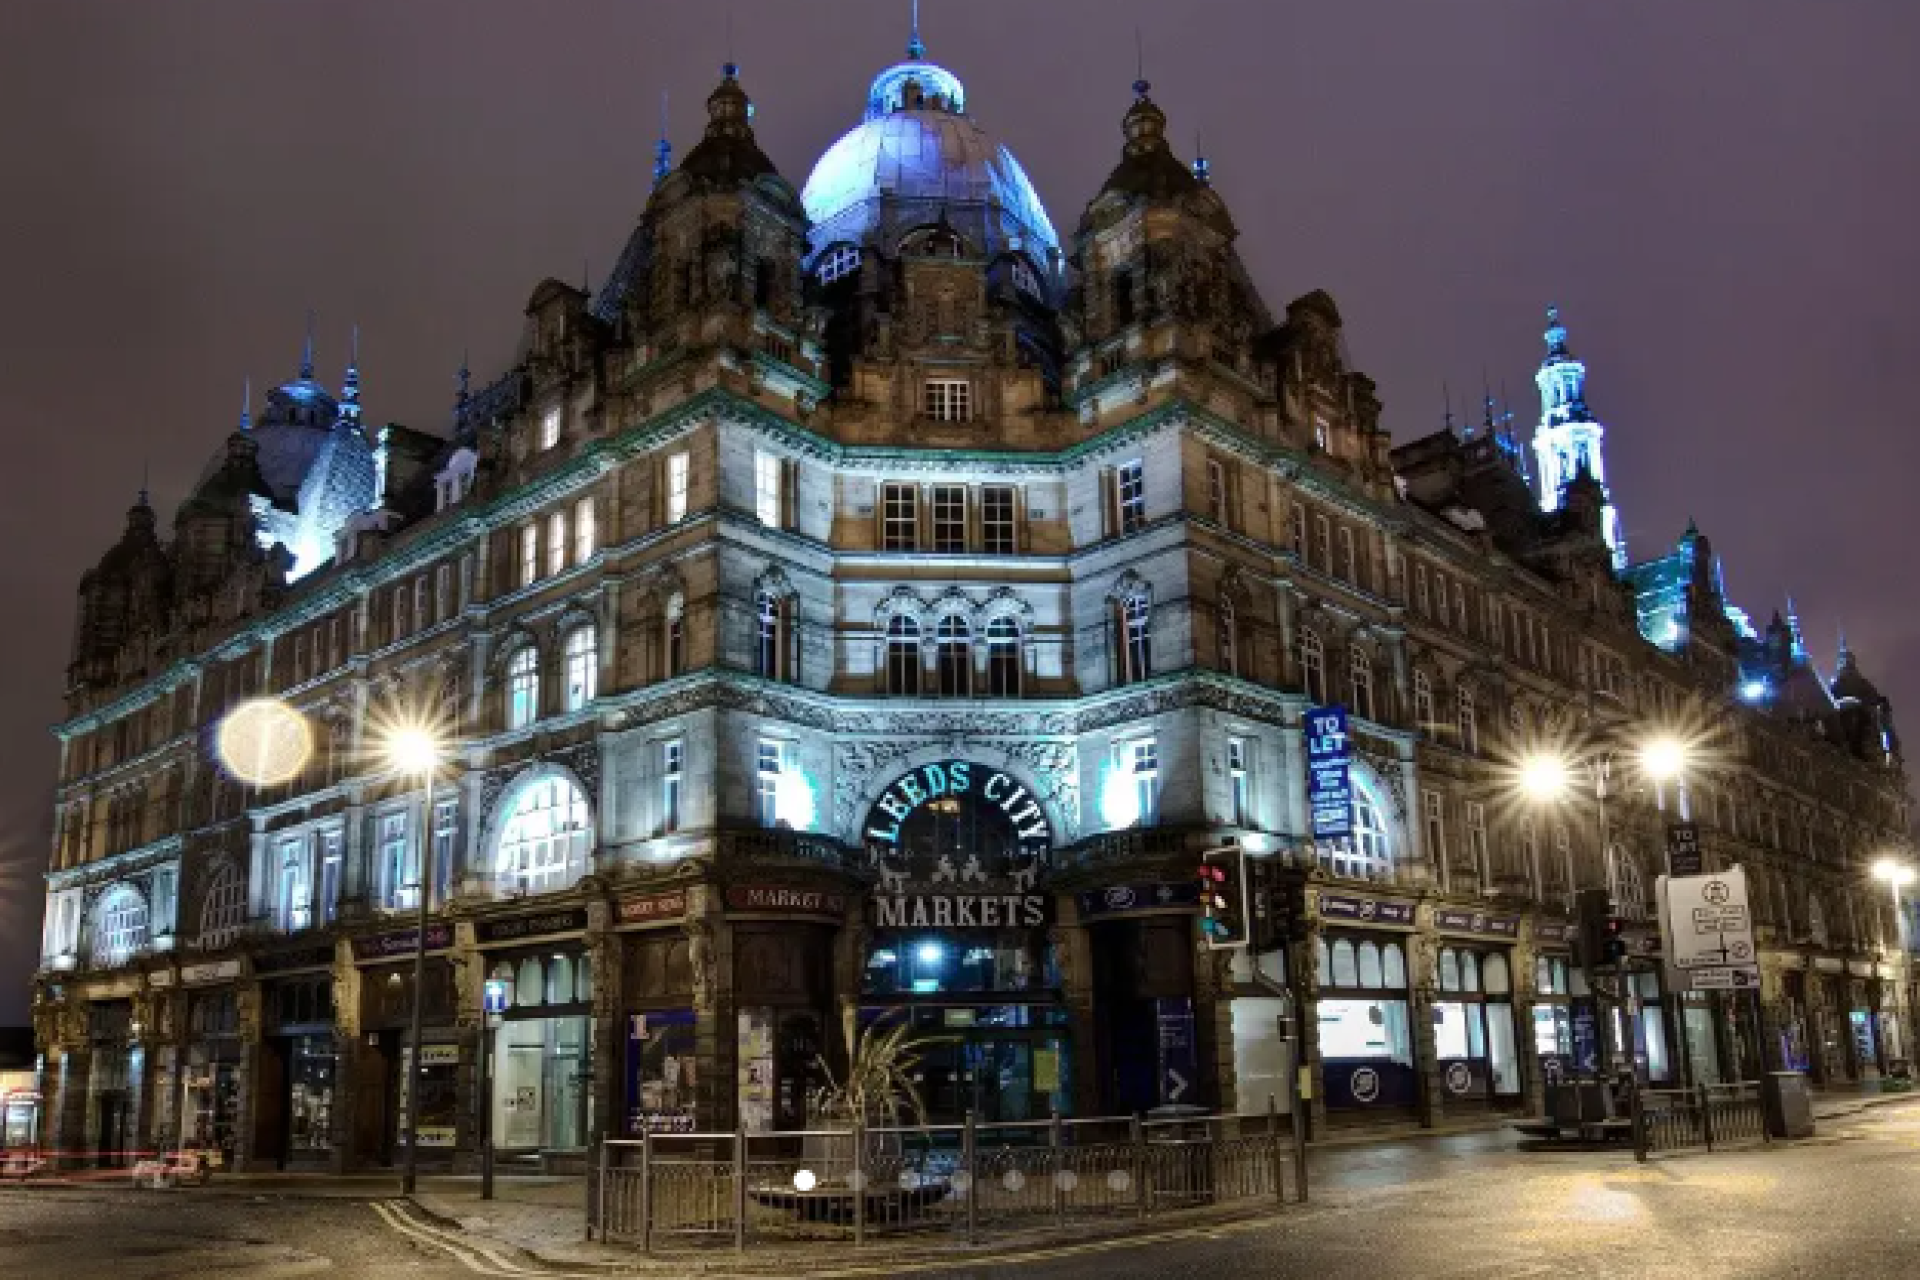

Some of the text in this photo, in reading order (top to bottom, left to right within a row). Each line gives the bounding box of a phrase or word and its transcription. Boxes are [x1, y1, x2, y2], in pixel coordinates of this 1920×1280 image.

[1313, 714, 1339, 735] TO
[1310, 732, 1346, 754] LET
[867, 761, 1050, 843] LEEDS CITY
[1674, 829, 1693, 841] TO
[747, 889, 822, 908] MARKET
[876, 895, 1044, 927] MARKETS
